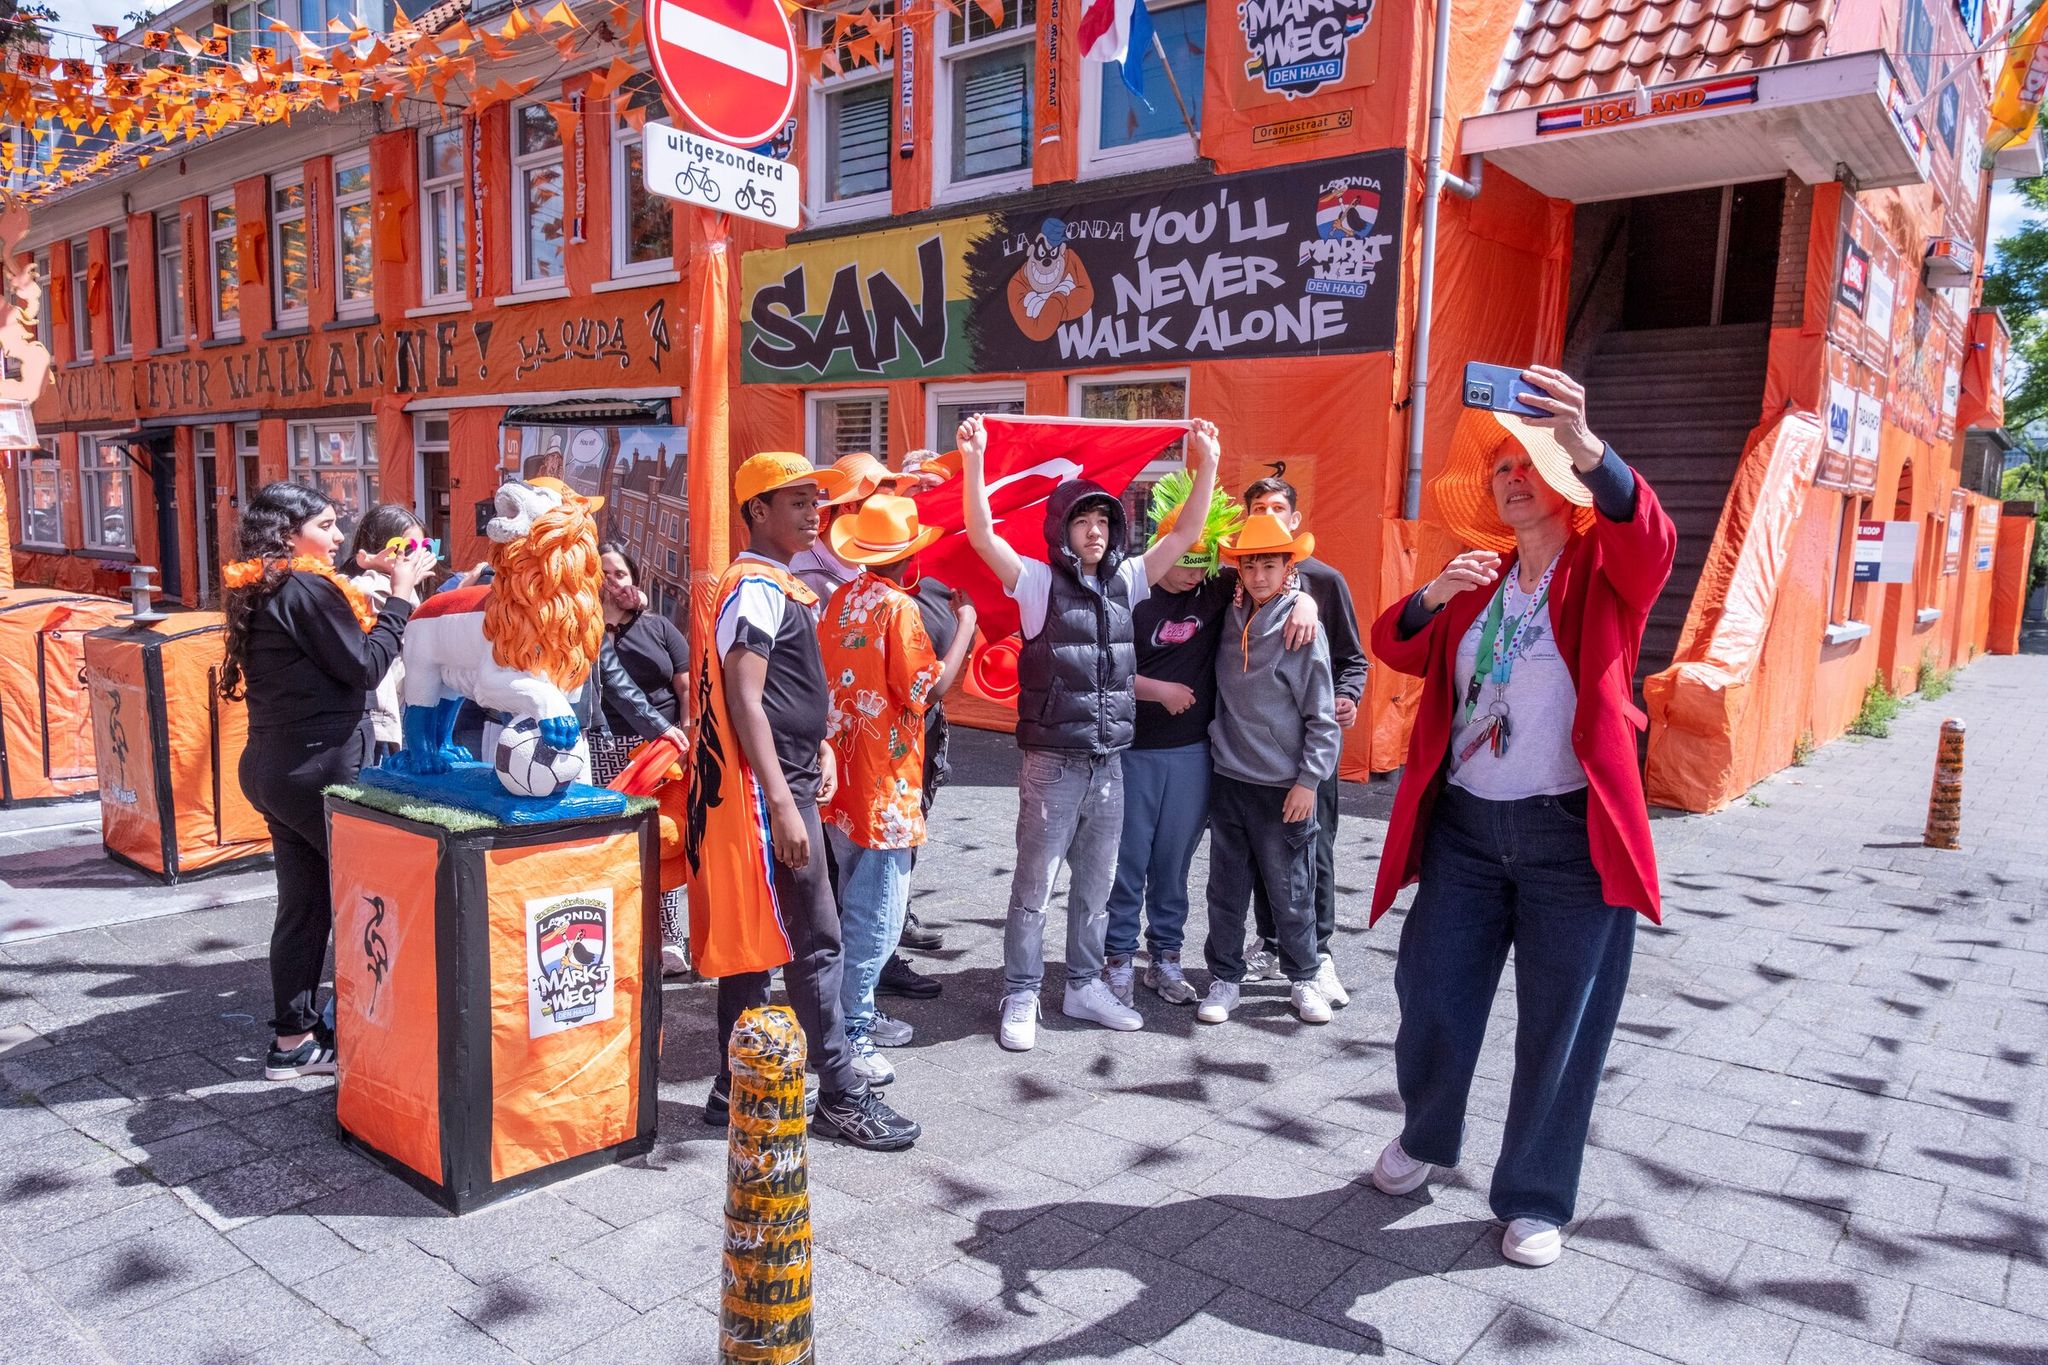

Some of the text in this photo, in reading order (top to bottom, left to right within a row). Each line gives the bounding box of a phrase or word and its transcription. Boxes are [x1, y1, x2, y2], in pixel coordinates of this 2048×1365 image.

[1264, 17, 1343, 66] WEG
[1273, 63, 1335, 83] DEN HAAG
[1581, 88, 1706, 127] HOLAND
[1260, 118, 1329, 137] Oranjestraat
[667, 133, 783, 181] uitgezonderd
[1320, 176, 1381, 194] LA ONDA
[1003, 188, 1289, 259] LA ONDA YOU'LL
[1298, 234, 1392, 266] MARKT
[1112, 252, 1285, 315] NEVER
[1308, 282, 1365, 296] DEN HAAG
[749, 234, 951, 373] SAN
[517, 317, 627, 360] LA ONDA
[1057, 295, 1348, 360] WALK ALONE
[133, 359, 212, 410] EVER
[224, 339, 314, 400] WALK
[539, 910, 603, 934] LA ONDA
[538, 964, 610, 996] MARKT
[551, 985, 595, 1011] WEG
[557, 1010, 573, 1020] DEN
